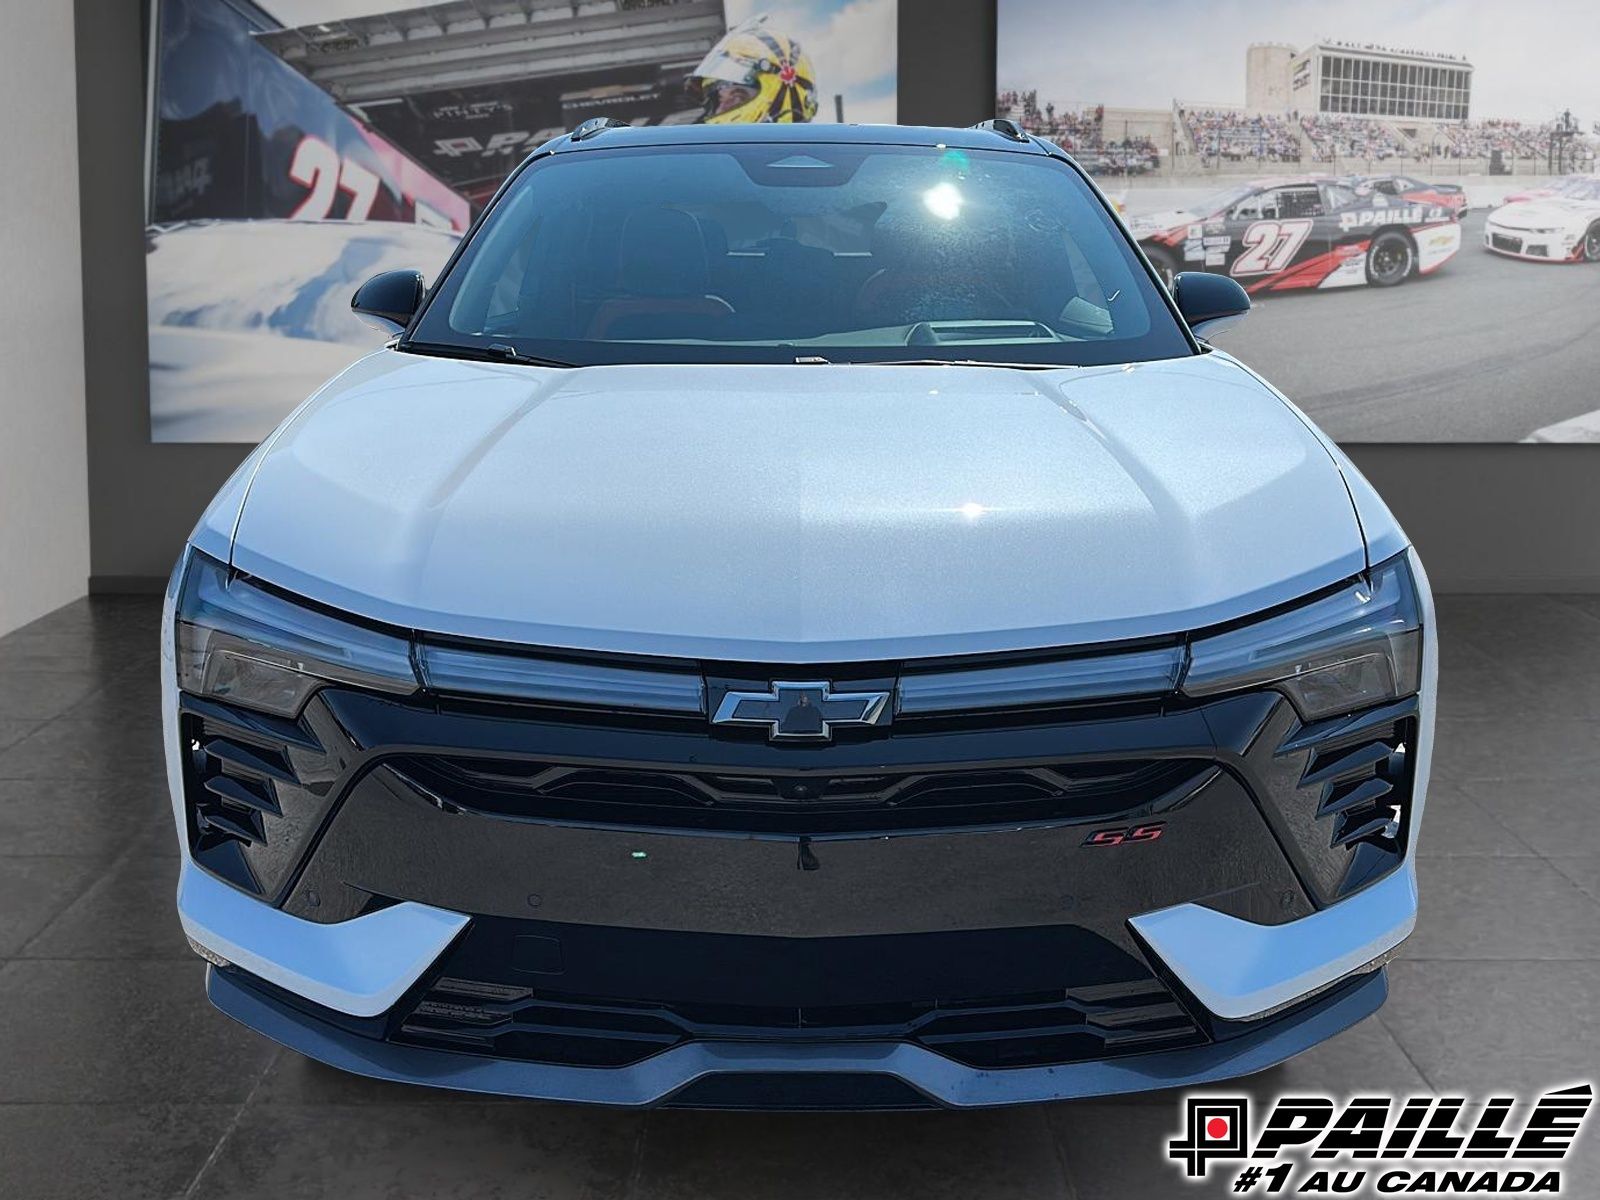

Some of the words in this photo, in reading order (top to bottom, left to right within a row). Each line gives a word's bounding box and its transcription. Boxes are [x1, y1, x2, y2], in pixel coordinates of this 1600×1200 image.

[562, 93, 661, 110] CHEVROLET
[288, 135, 380, 221] 27
[1229, 217, 1314, 277] 27
[1079, 821, 1168, 848] SS
